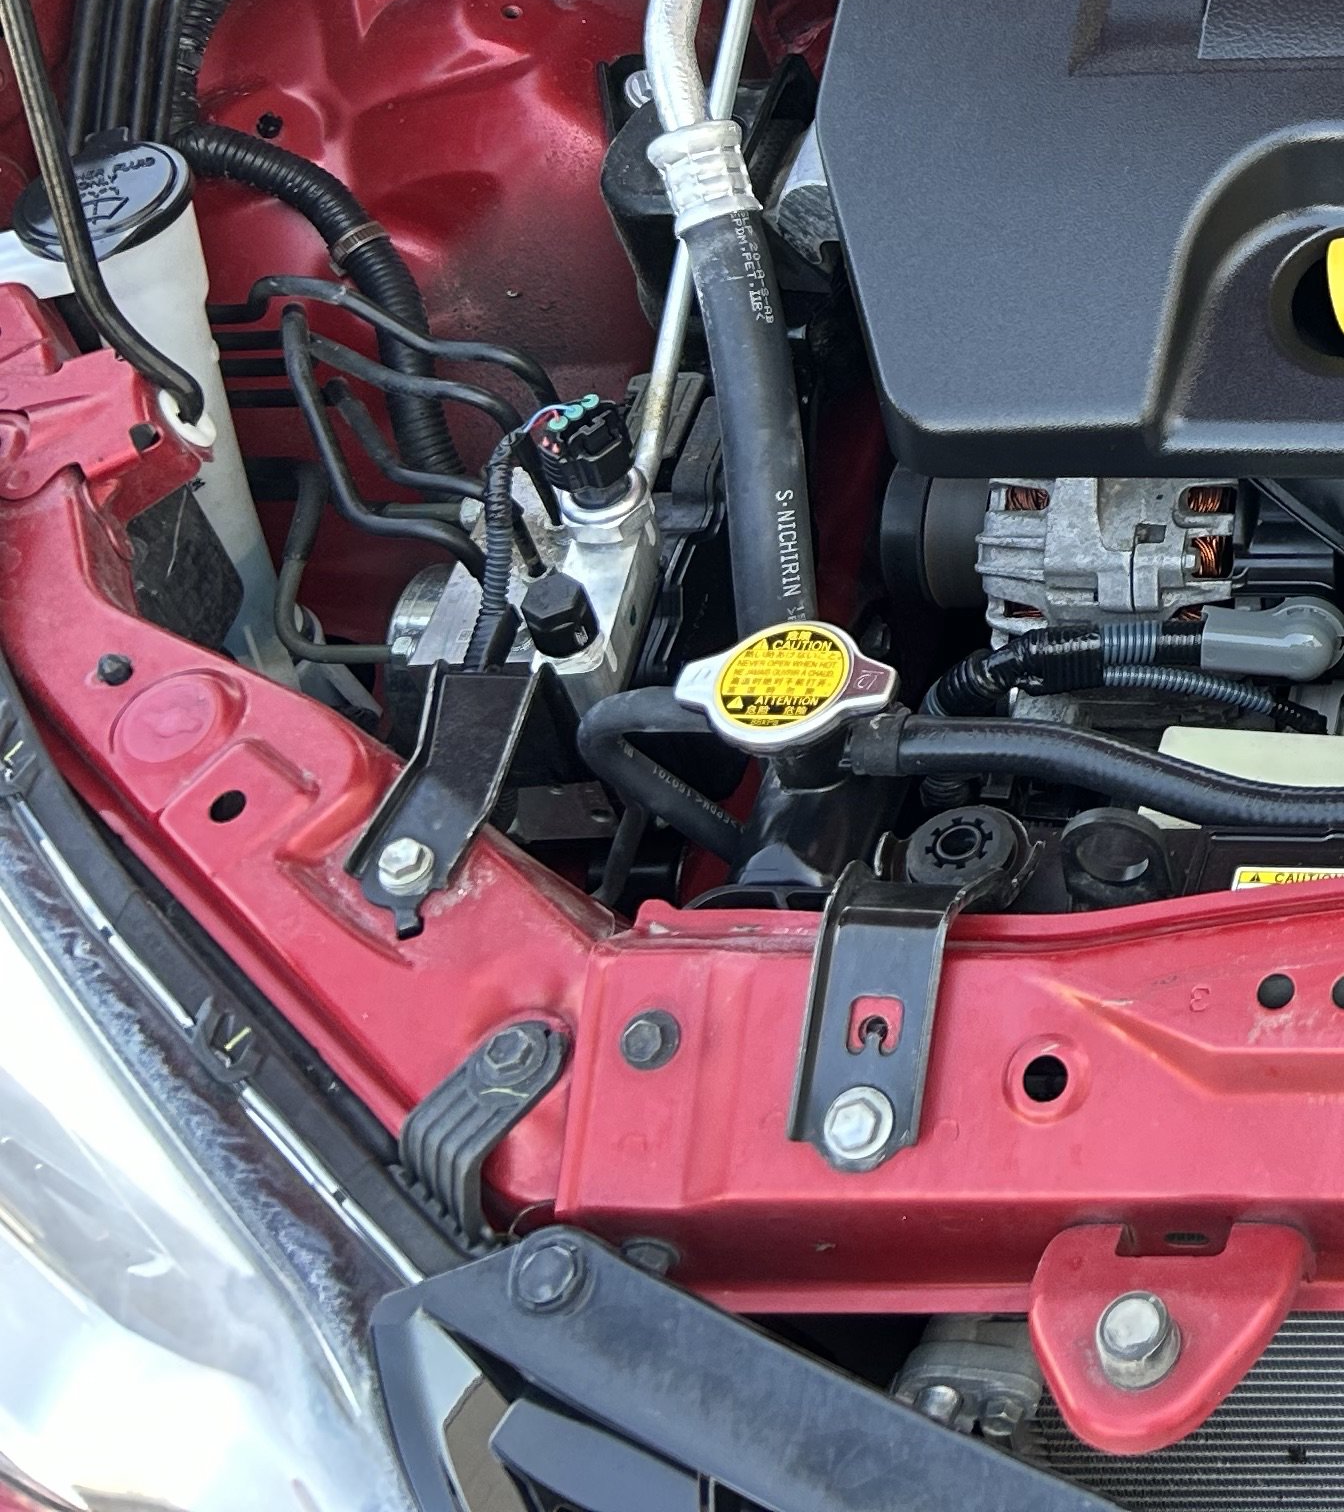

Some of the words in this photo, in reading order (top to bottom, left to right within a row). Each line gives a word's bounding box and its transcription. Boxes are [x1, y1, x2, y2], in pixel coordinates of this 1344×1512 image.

[772, 639, 833, 652] CAUTION
[737, 660, 765, 668] NEVER
[767, 660, 791, 668] OPEN
[792, 660, 818, 668] WHEN
[818, 661, 838, 669] HOT
[755, 696, 819, 706] ATTENTION
